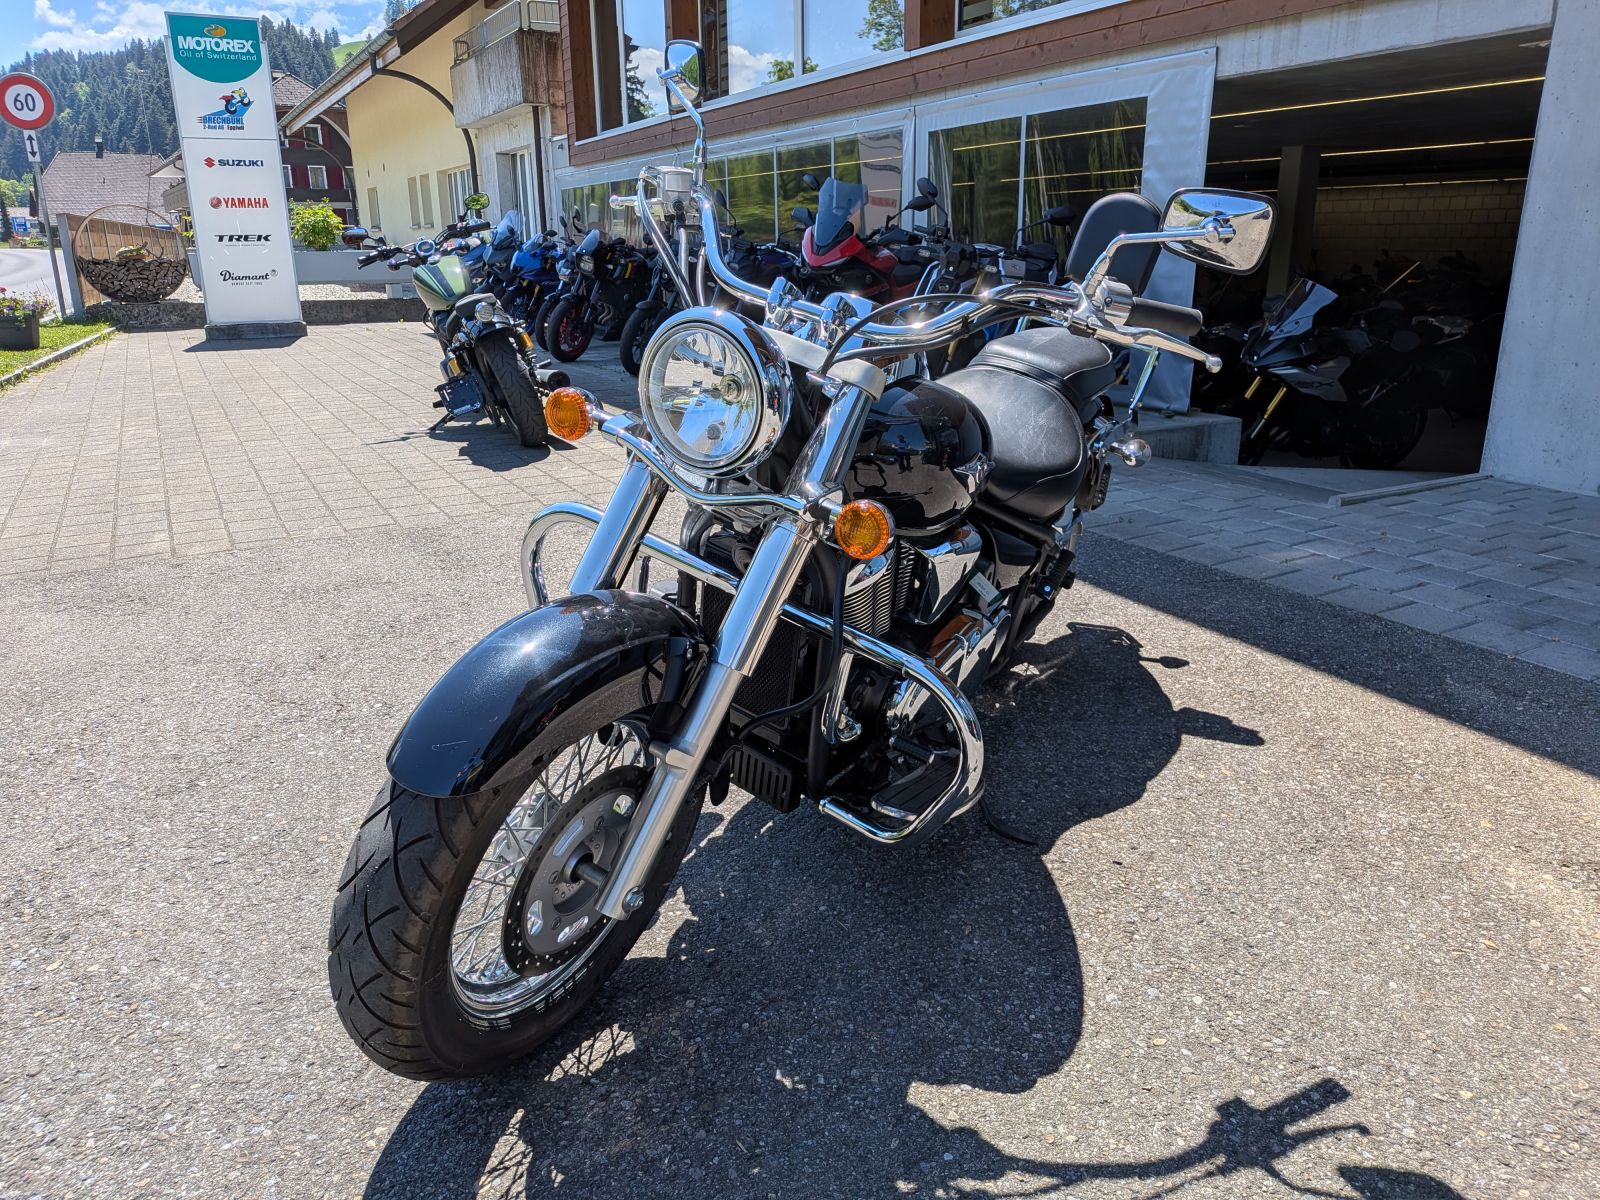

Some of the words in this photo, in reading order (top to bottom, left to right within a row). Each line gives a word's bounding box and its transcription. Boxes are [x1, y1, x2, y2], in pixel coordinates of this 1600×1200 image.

[177, 35, 255, 53] MOTOREX
[180, 50, 192, 58] Oil
[195, 50, 204, 58] of
[207, 51, 257, 61] Switzerland
[13, 92, 36, 112] 60
[218, 158, 264, 168] SUZUKI
[223, 197, 269, 209] YAMAHA
[214, 234, 272, 243] TREK
[220, 269, 270, 282] Diamant
